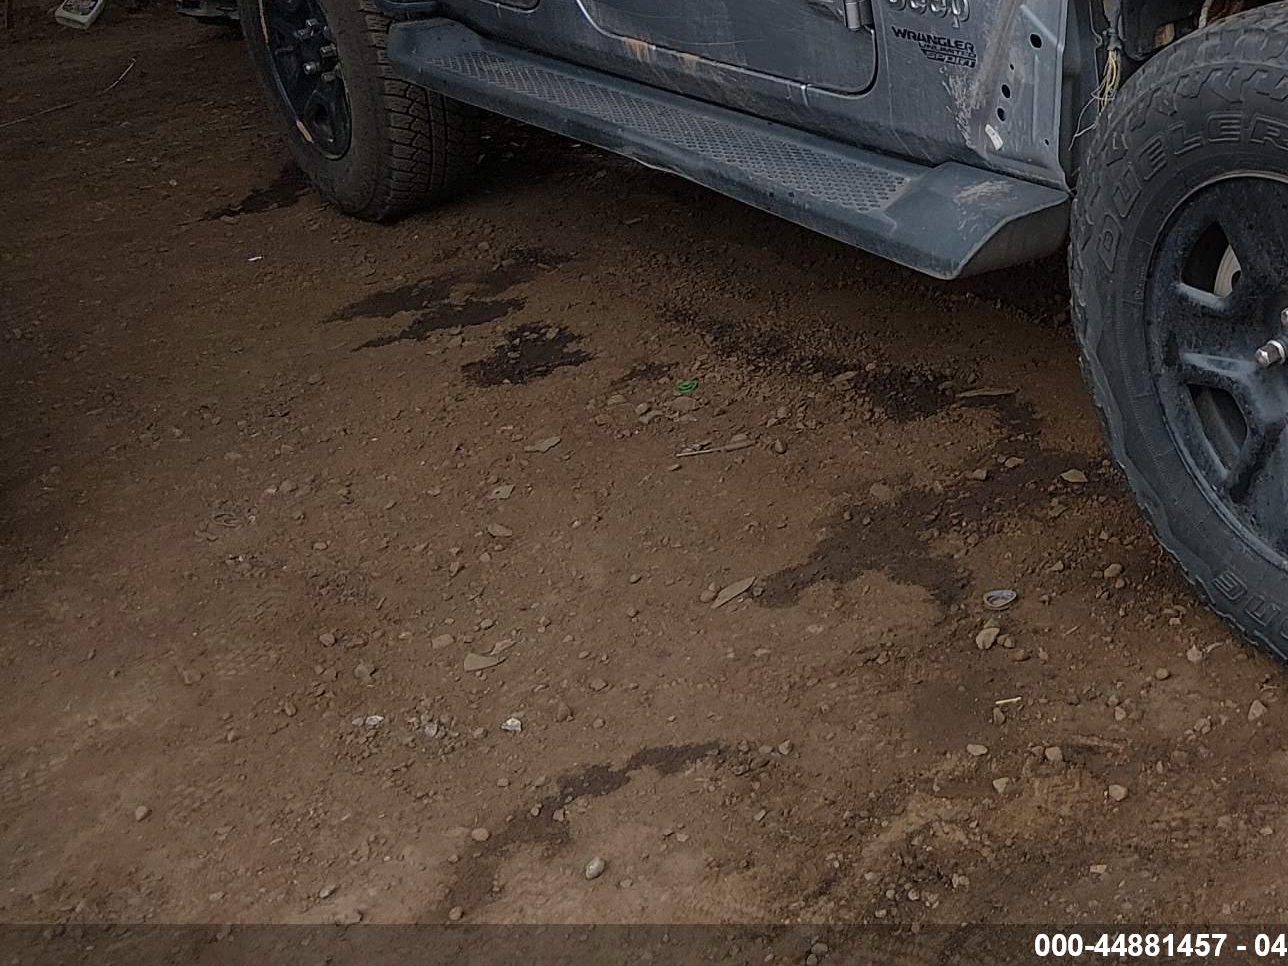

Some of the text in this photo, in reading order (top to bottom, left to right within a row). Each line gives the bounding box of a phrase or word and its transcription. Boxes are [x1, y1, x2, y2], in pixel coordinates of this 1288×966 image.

[891, 25, 975, 52] WRANGLER
[919, 42, 977, 59] UNLIMITED
[923, 50, 976, 68] SPORT
